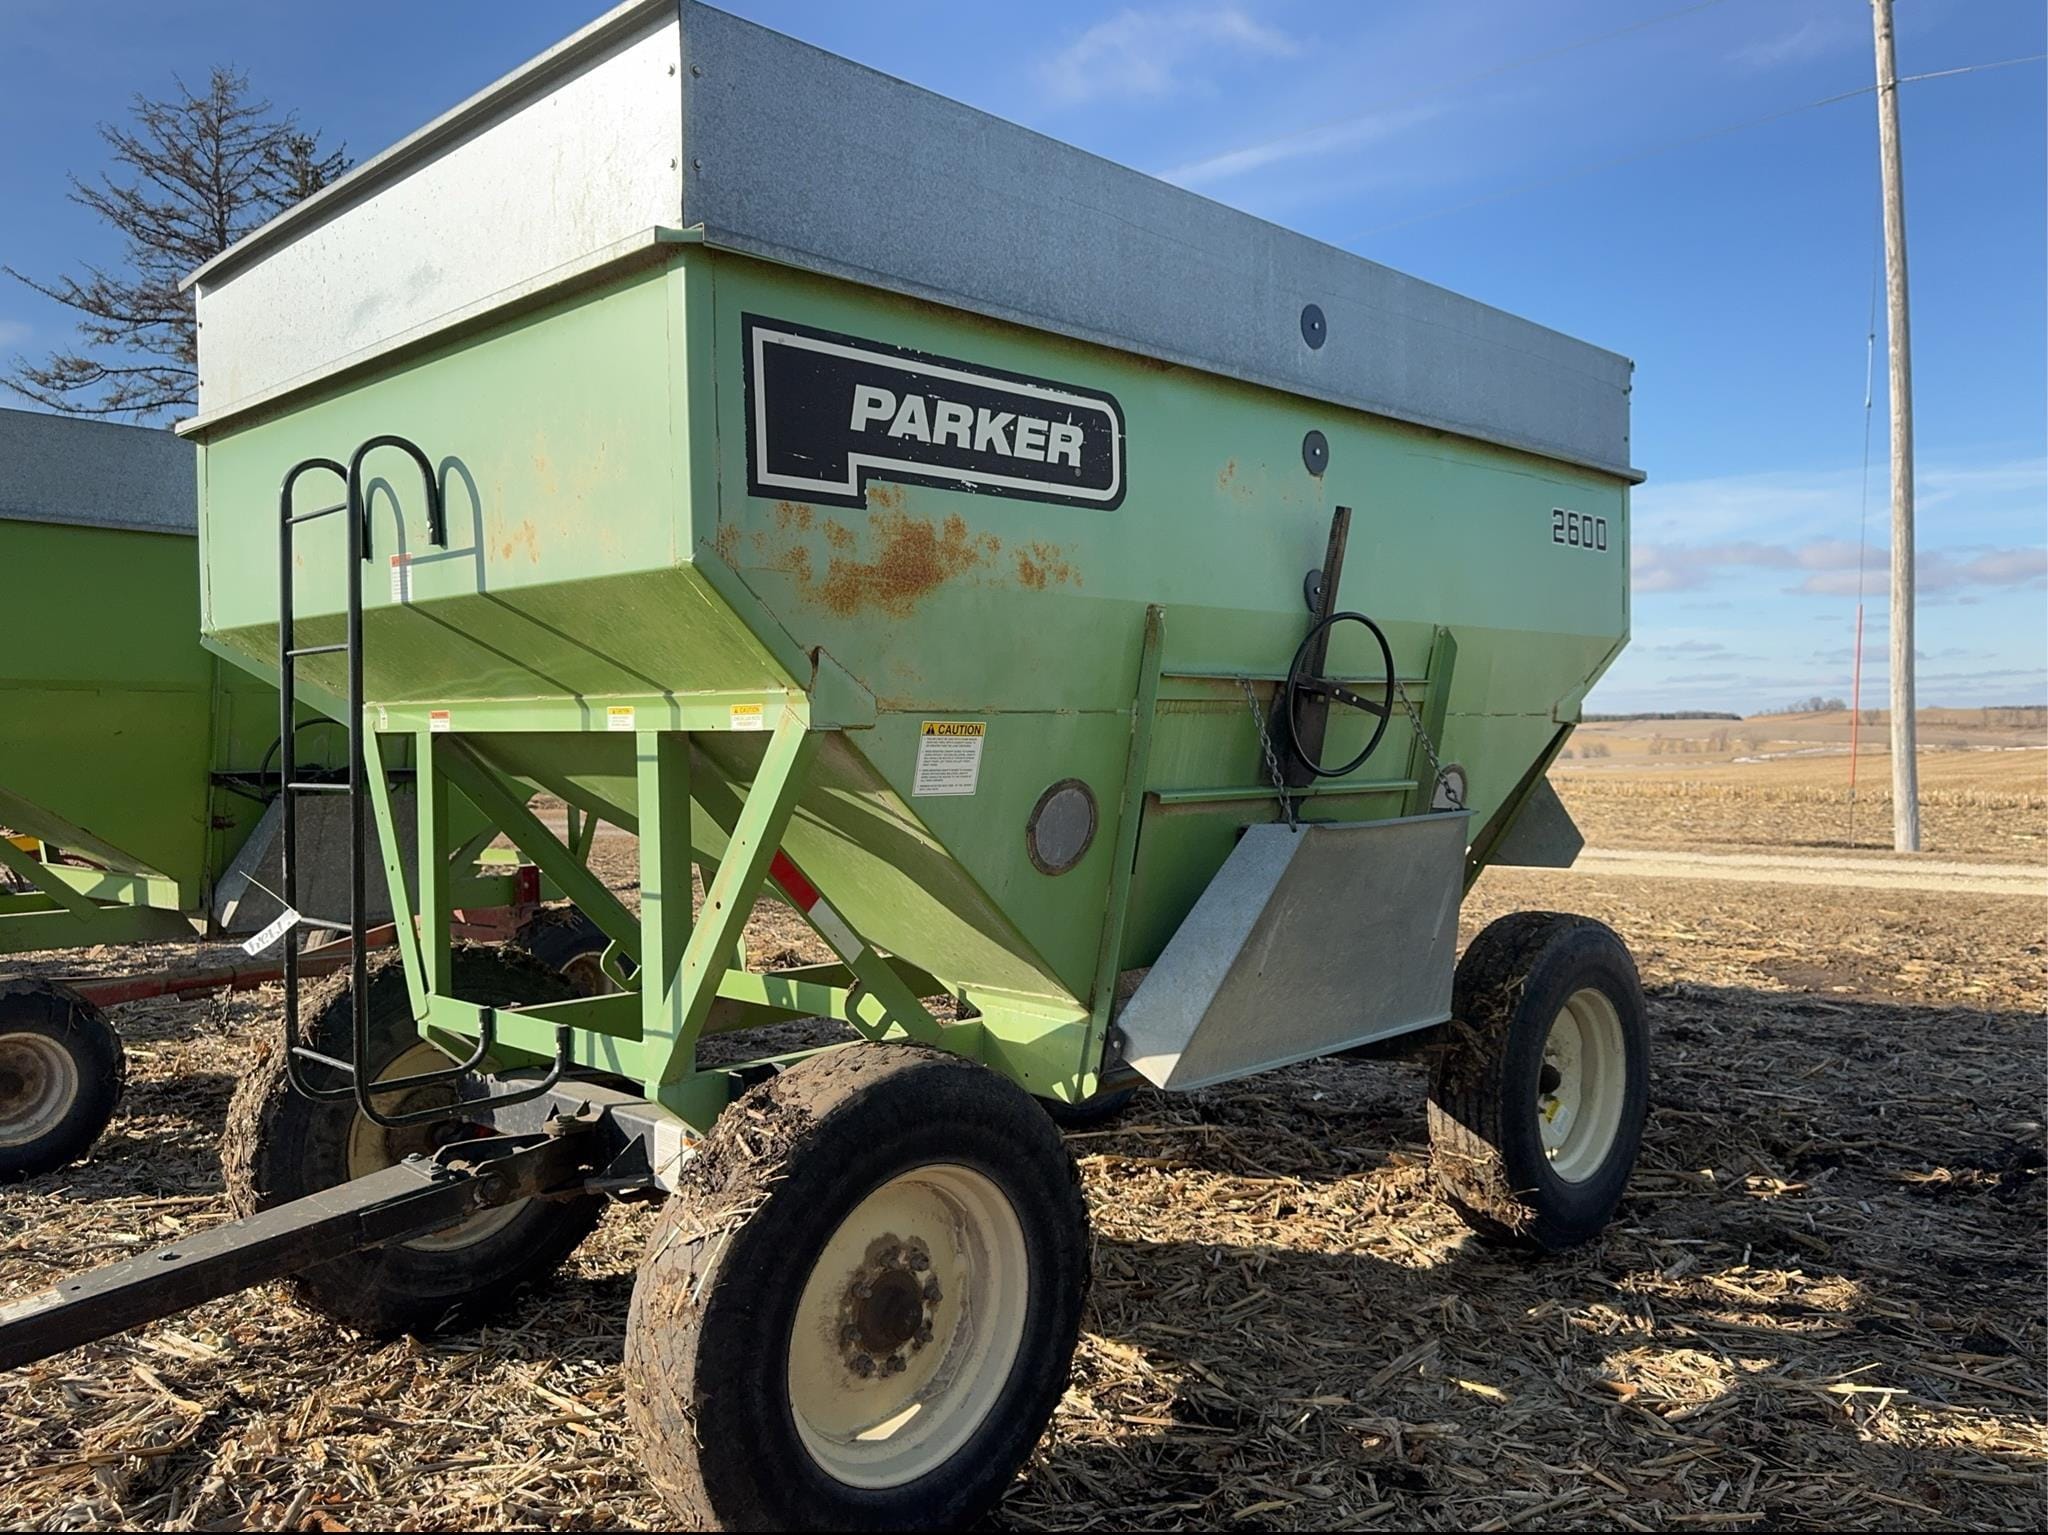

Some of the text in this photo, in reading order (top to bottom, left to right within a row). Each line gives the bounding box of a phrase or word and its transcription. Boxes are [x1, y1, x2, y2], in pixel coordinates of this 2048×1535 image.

[850, 383, 1084, 467] PARKER
[1552, 509, 1607, 551] 2600
[937, 723, 982, 735] CAUTION
